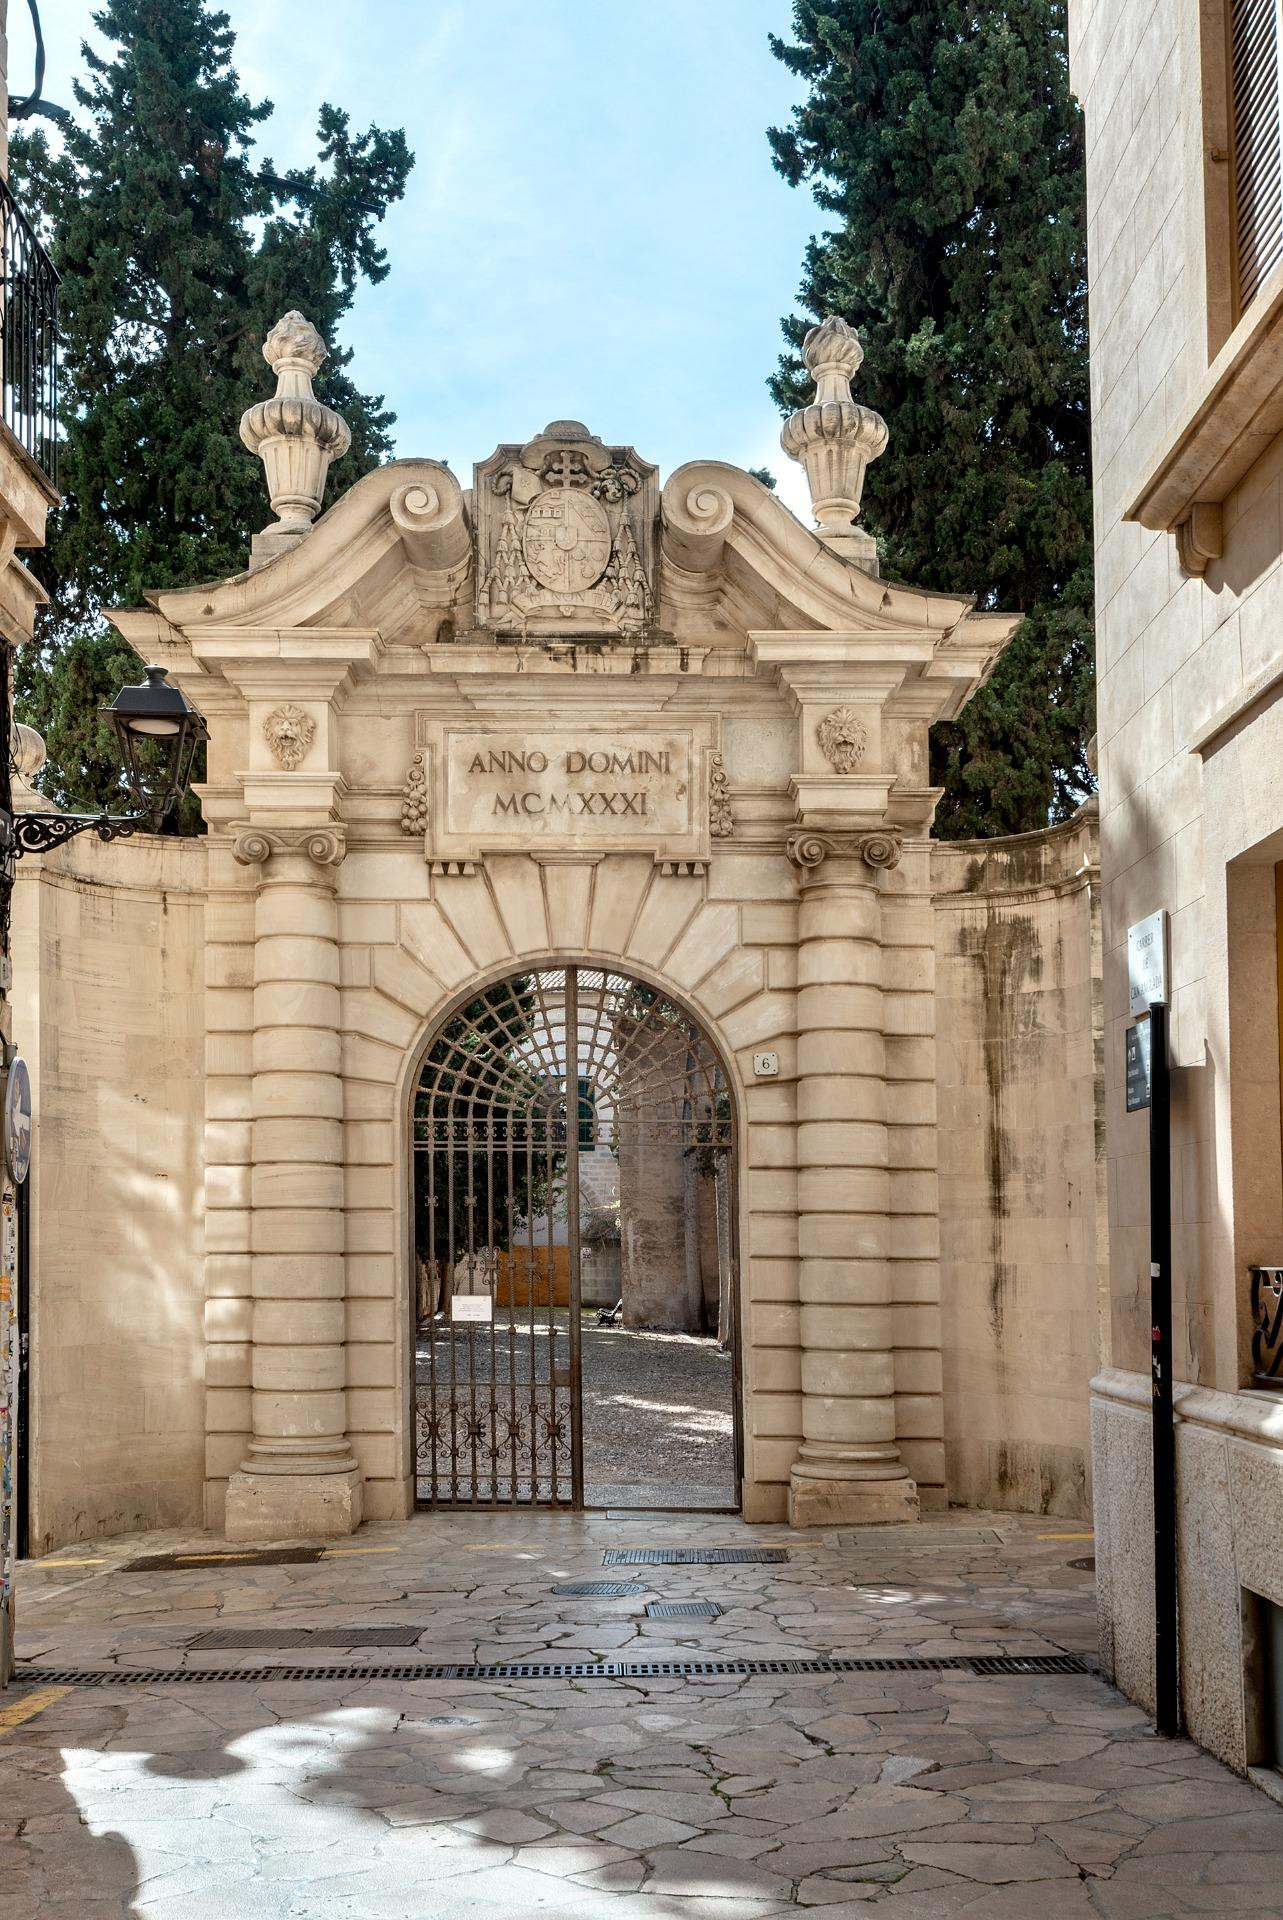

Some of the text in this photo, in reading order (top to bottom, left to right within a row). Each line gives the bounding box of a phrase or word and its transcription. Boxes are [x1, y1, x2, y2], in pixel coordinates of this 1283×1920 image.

[468, 751, 671, 774] ANNO DOMINI
[491, 792, 648, 815] MCMXXXI
[762, 1057, 770, 1069] 6
